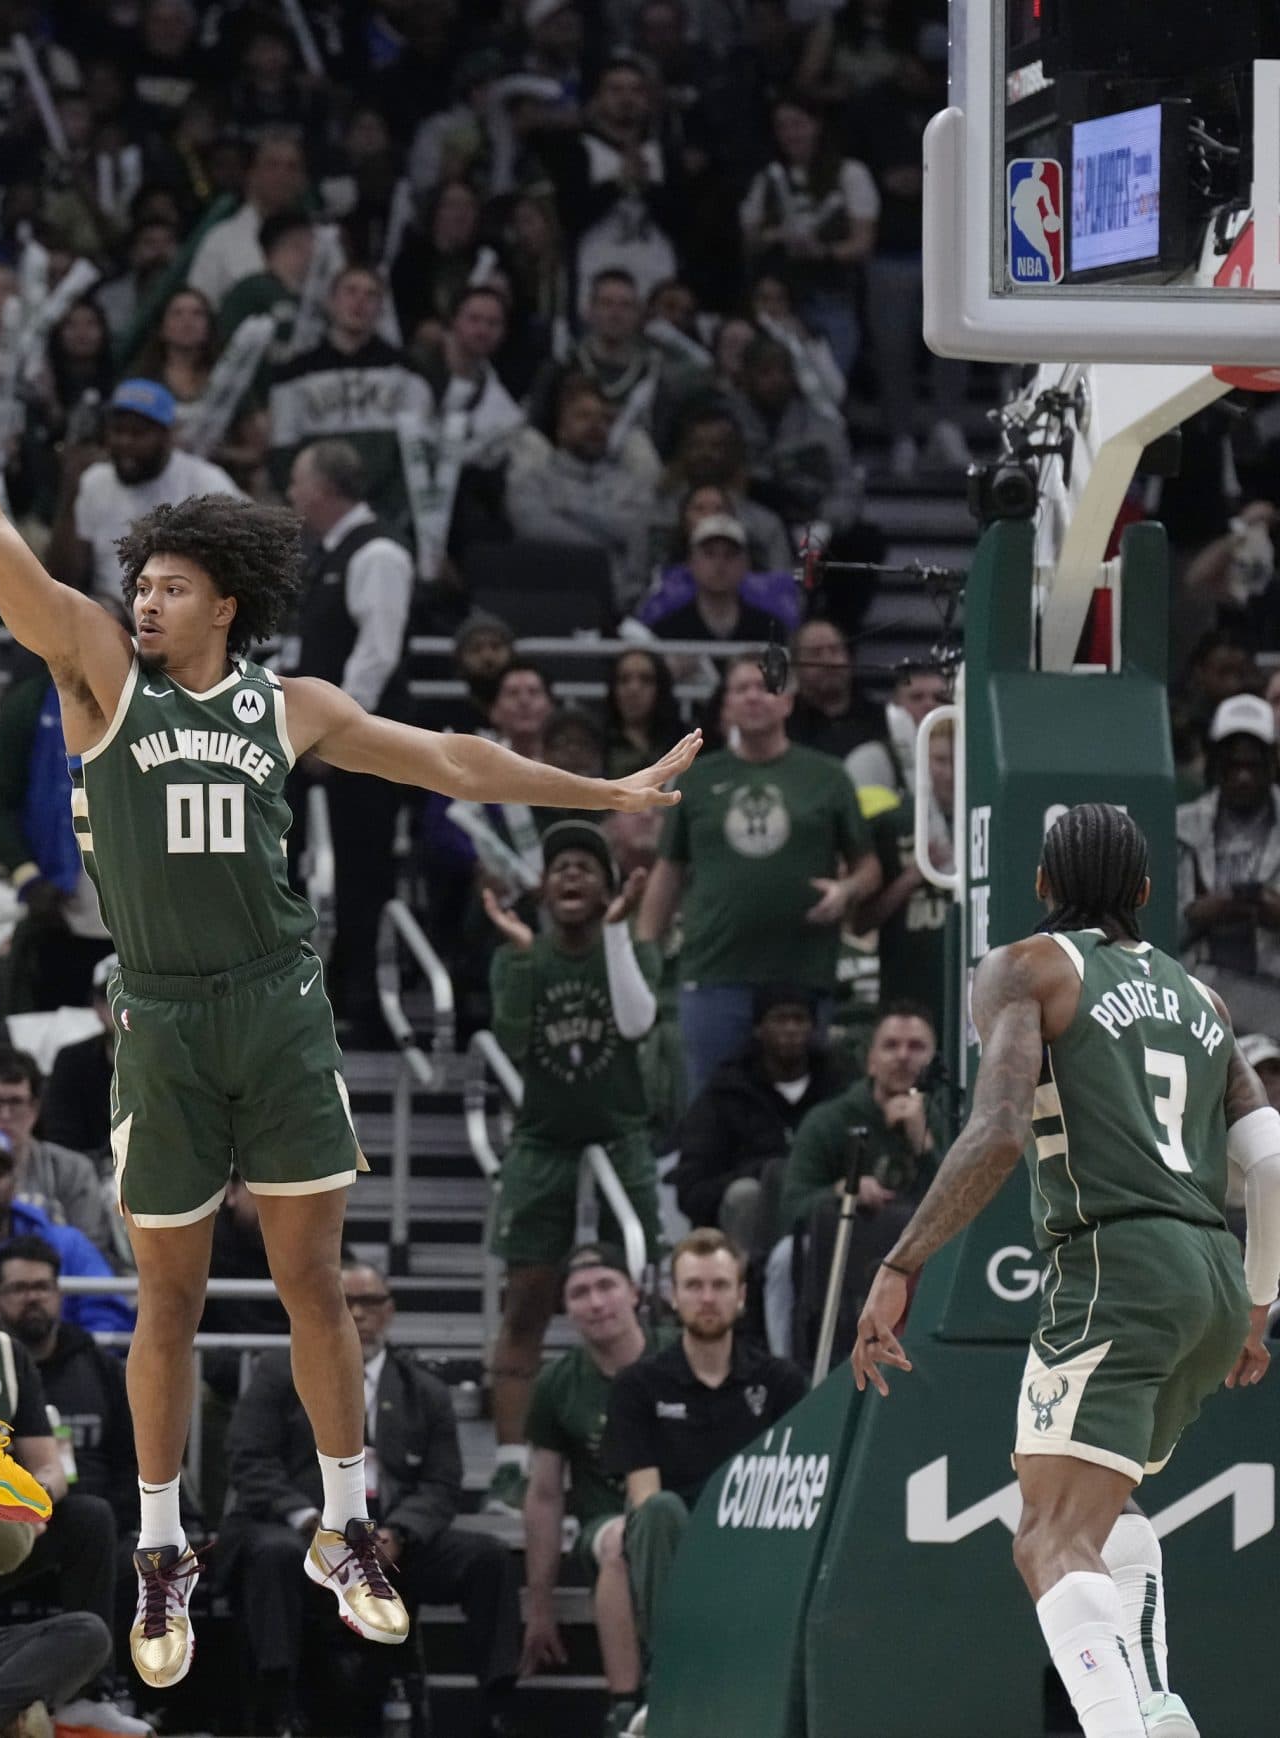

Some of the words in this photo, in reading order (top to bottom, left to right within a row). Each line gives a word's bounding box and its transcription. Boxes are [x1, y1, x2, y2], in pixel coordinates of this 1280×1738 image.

[1017, 256, 1043, 277] NBA
[129, 727, 275, 786] MILWAUKEE
[166, 783, 245, 854] 00
[1089, 979, 1182, 1040] PORTER
[1190, 1010, 1225, 1057] JR
[1144, 1045, 1193, 1174] 3
[717, 1426, 830, 1530] coinbase
